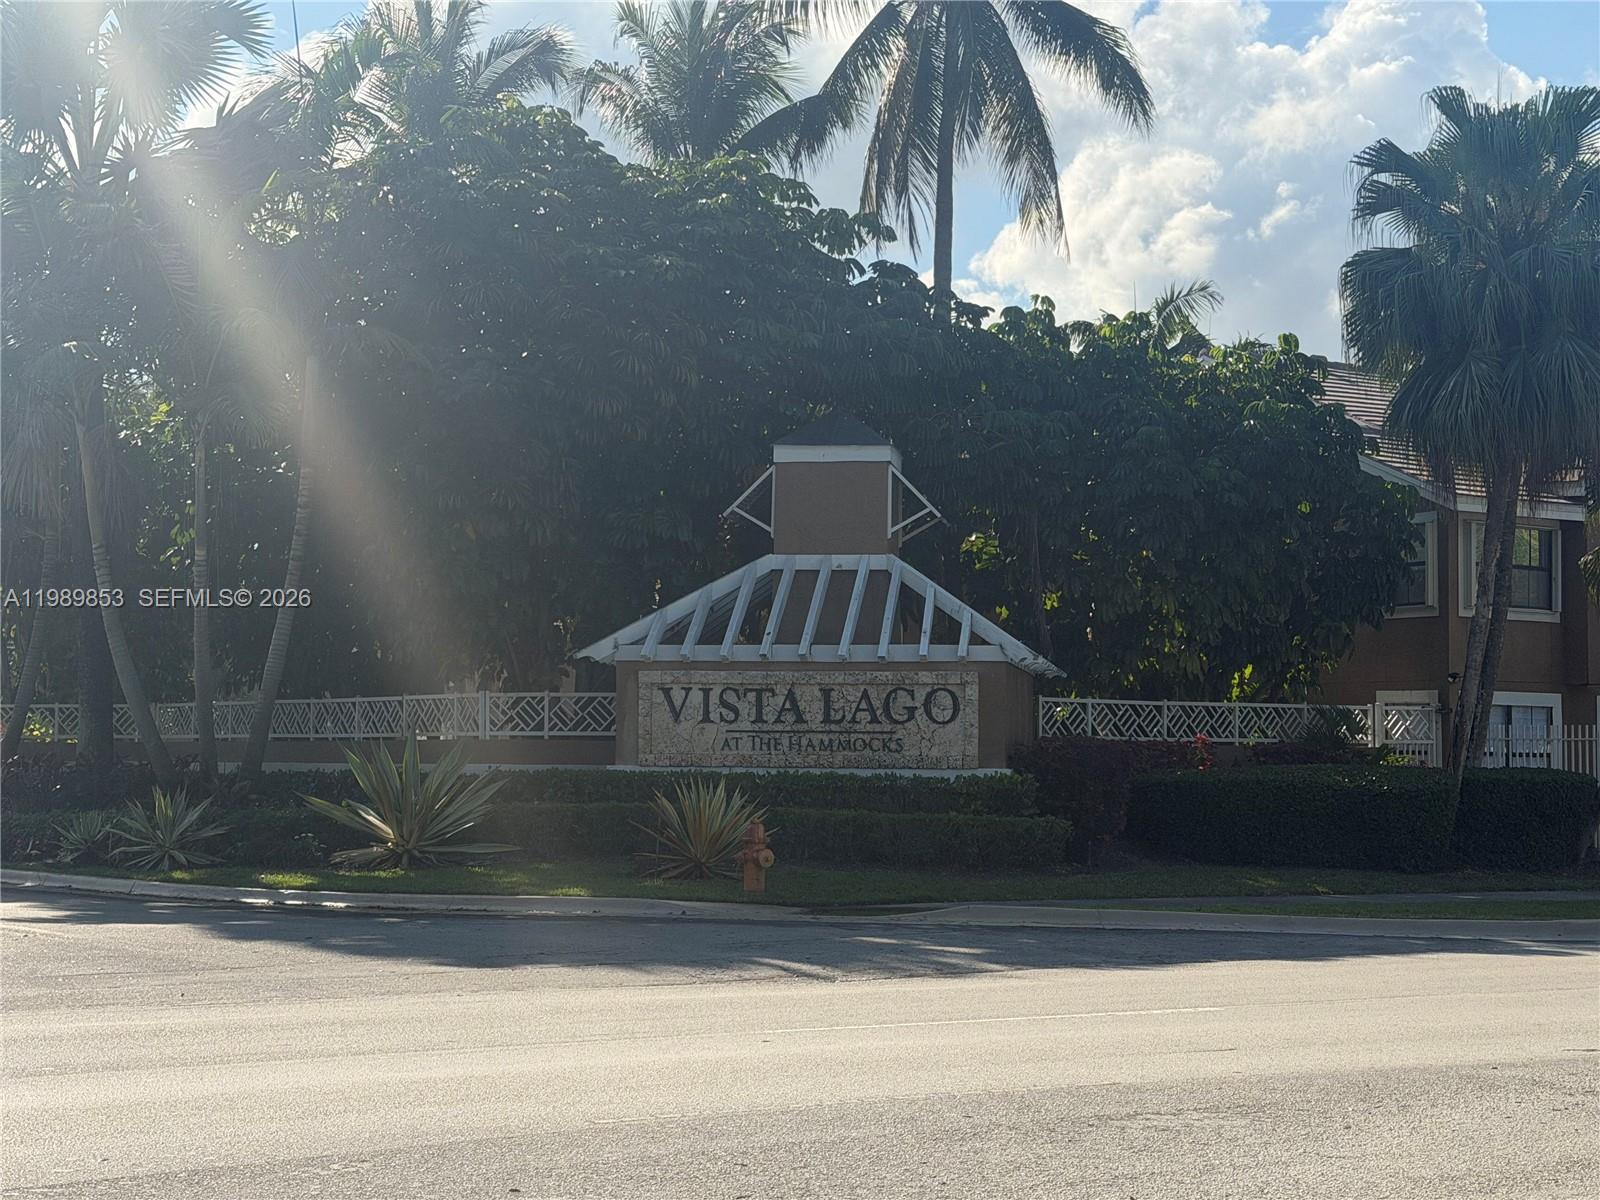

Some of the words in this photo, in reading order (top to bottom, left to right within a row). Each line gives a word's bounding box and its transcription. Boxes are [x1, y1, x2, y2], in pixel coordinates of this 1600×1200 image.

[658, 686, 809, 725] VISTA
[819, 686, 961, 726] LAGO
[721, 737, 743, 752] AT
[748, 735, 783, 752] THE
[788, 735, 904, 753] HAMMOCKS
